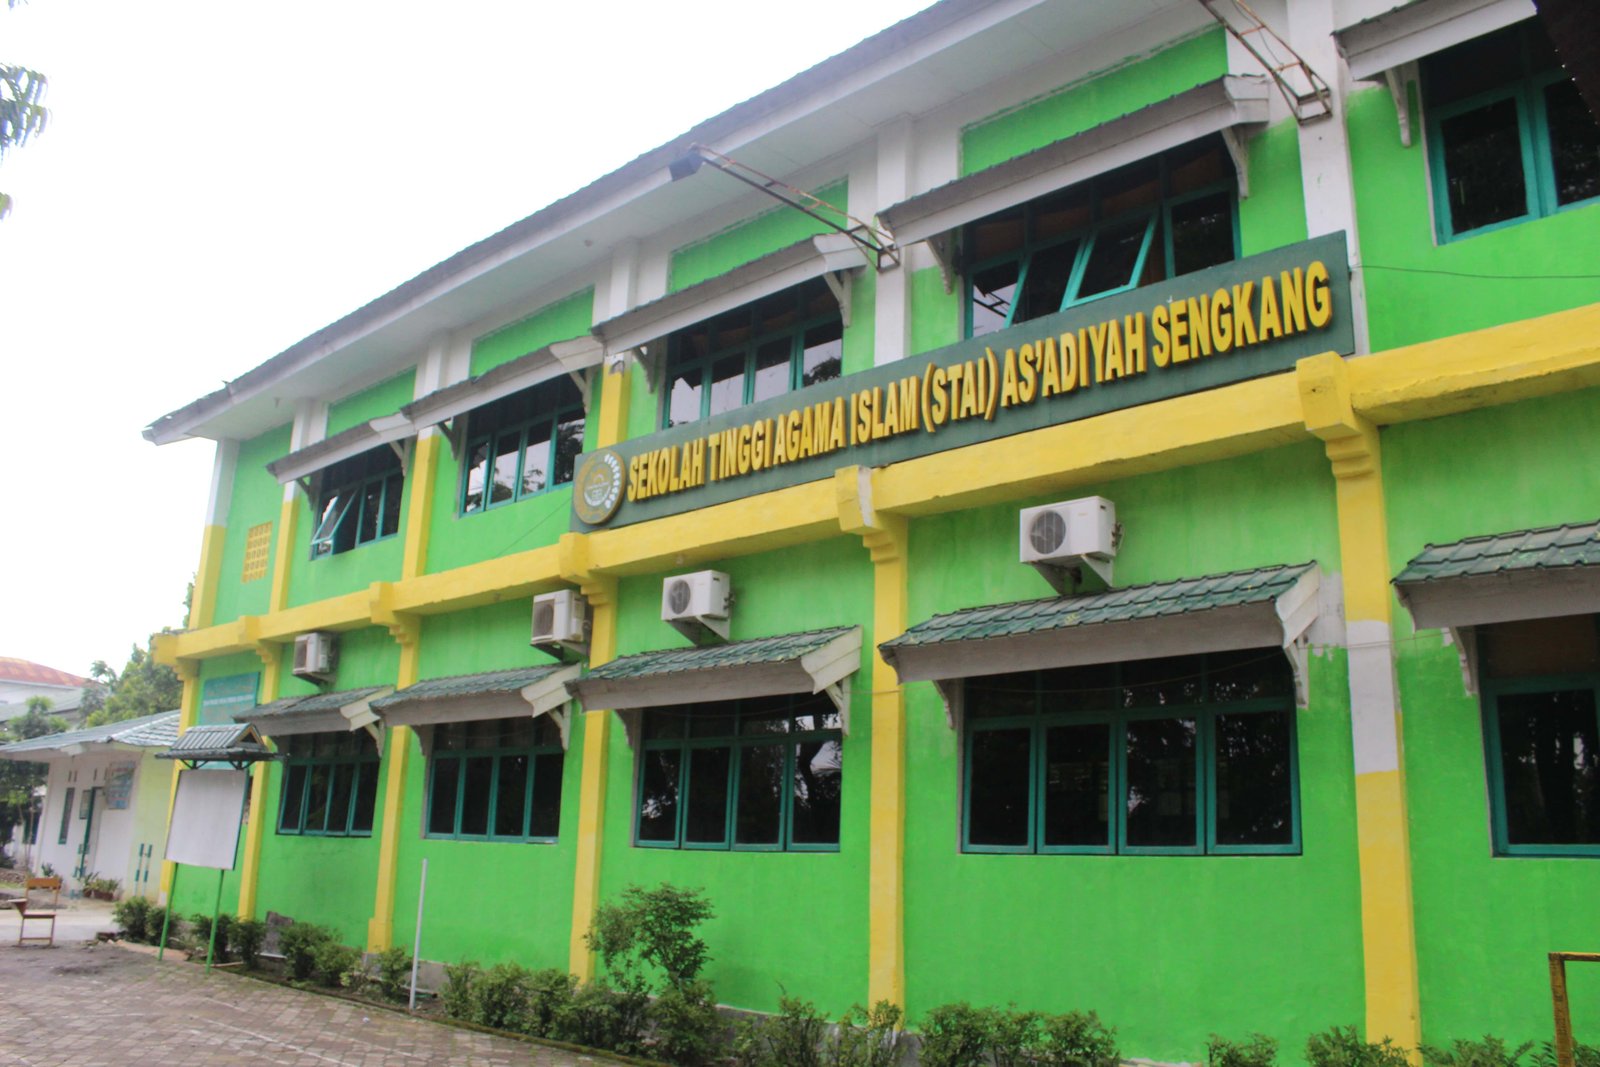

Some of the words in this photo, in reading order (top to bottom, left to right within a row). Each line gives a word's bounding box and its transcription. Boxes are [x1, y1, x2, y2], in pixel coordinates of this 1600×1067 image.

[627, 438, 706, 502] SEKOLAH
[708, 419, 774, 481] TINGGI
[773, 396, 846, 465] AGAMA
[850, 375, 920, 446] ISLAM
[921, 346, 999, 433] (STAI)
[1001, 312, 1147, 408] AS'ADIYAH
[1151, 260, 1333, 368] SENGKANG
